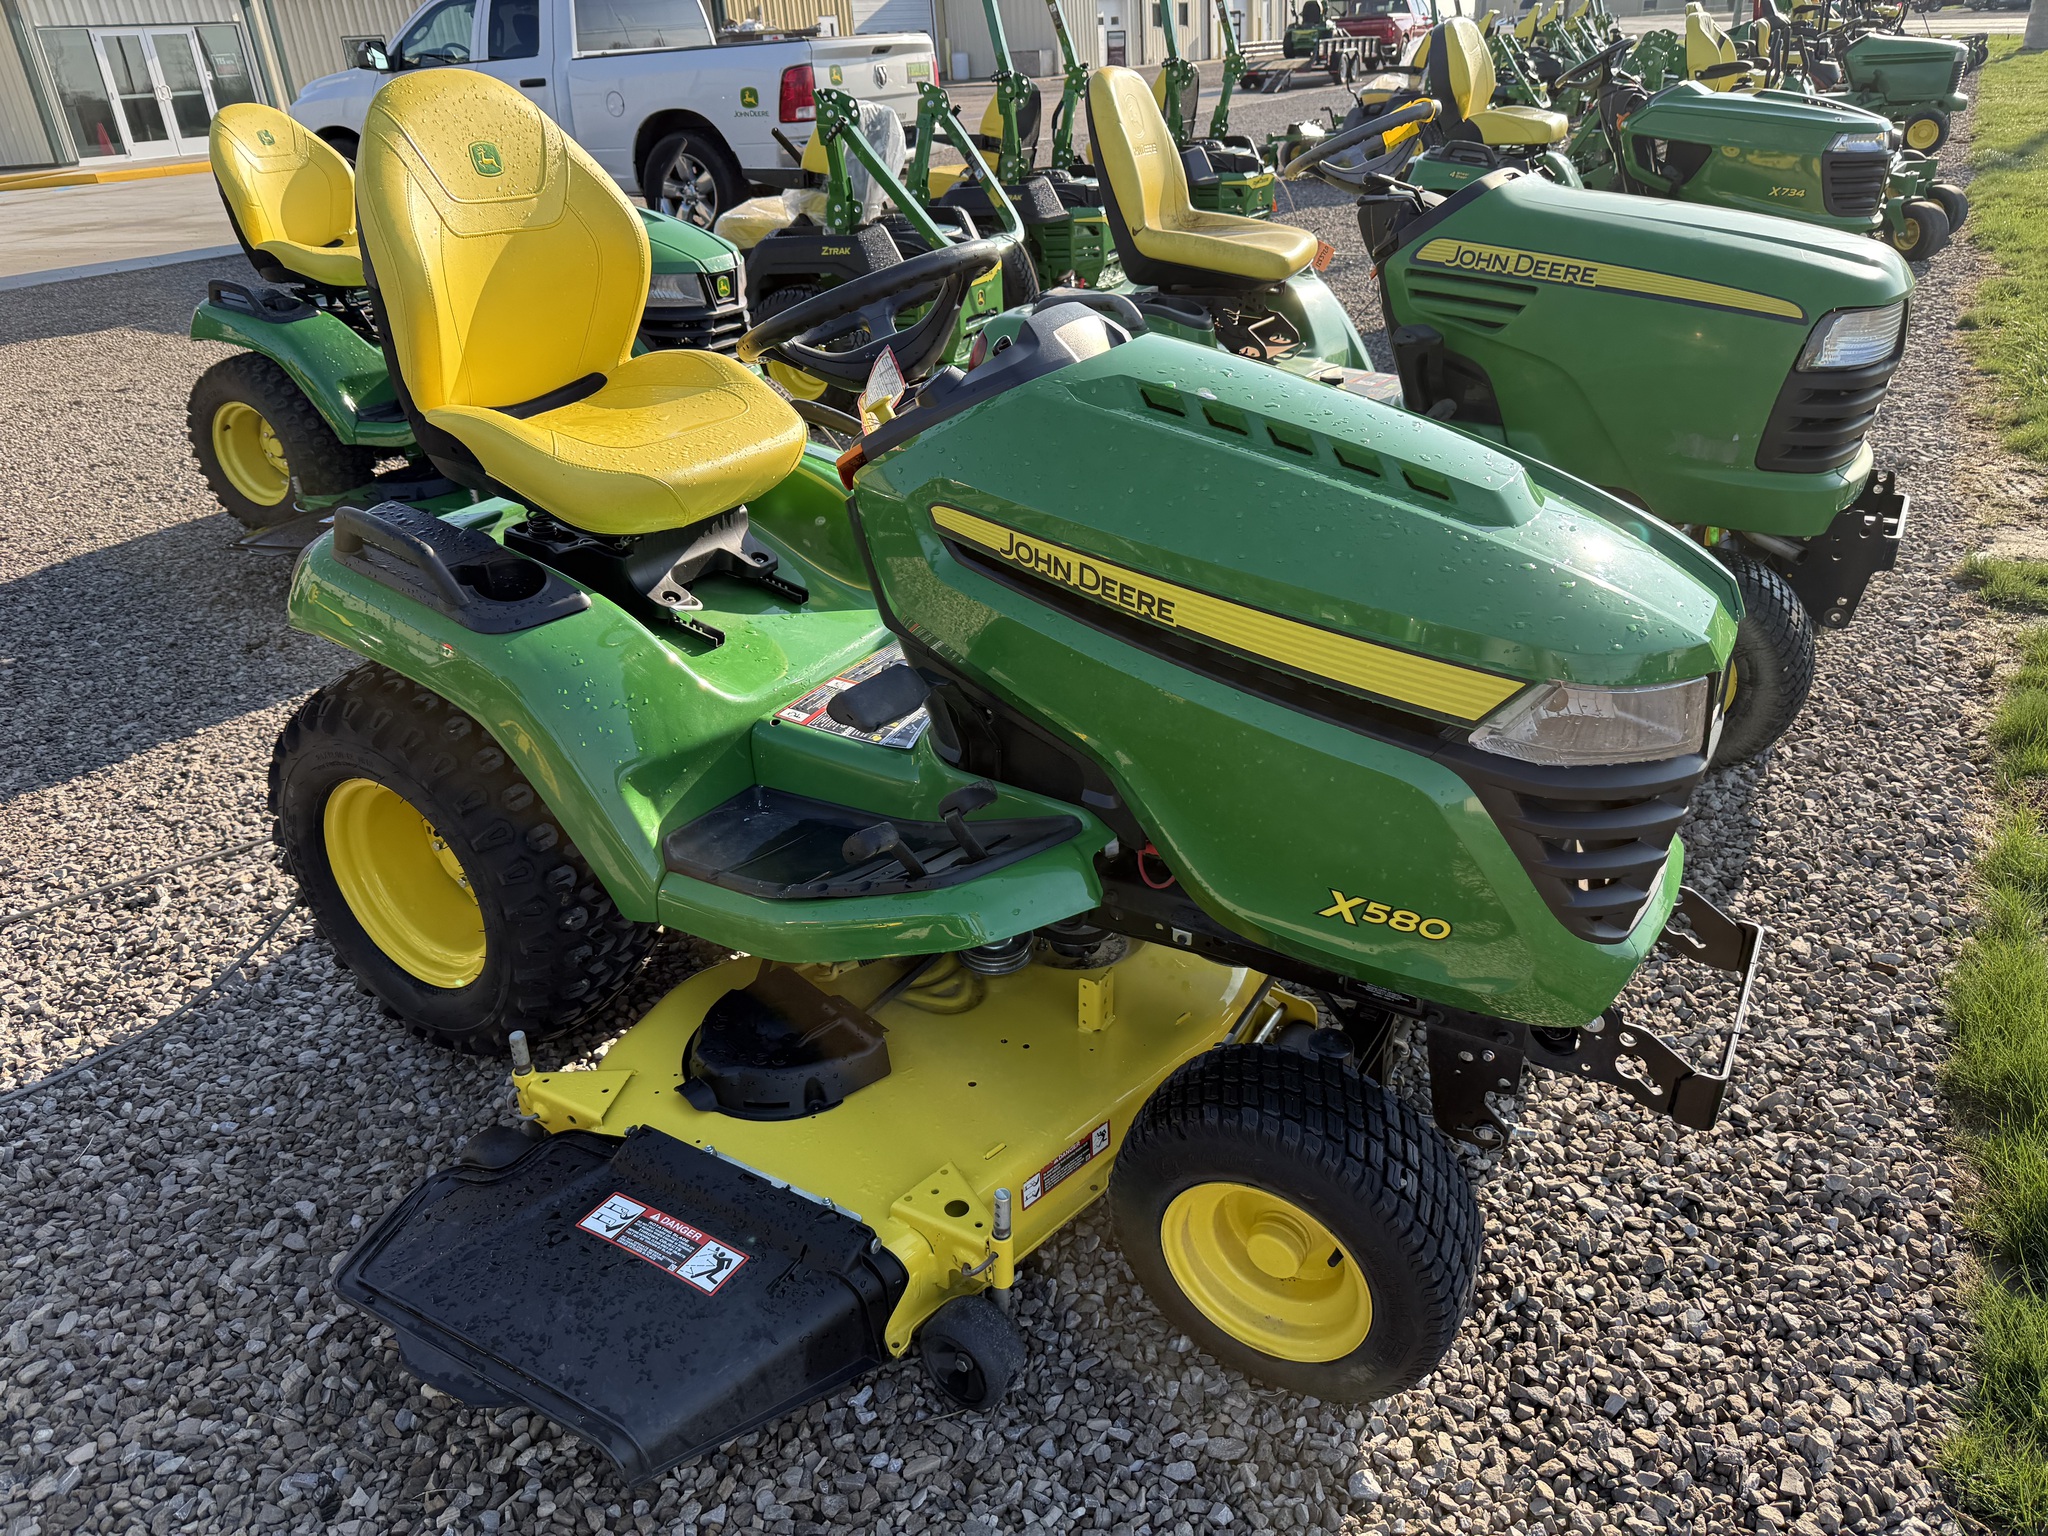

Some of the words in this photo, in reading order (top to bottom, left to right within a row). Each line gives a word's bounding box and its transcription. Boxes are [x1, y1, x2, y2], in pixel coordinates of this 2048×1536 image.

[750, 109, 770, 117] DEERE
[1768, 186, 1805, 197] X734
[821, 246, 851, 256] ZTRAK
[1445, 245, 1510, 272] JOHN
[1513, 253, 1598, 284] DEERE
[999, 533, 1072, 583] JOHN
[1079, 561, 1176, 624] DEERE
[1315, 888, 1452, 940] X580
[1058, 1141, 1081, 1160] DANGER
[660, 1216, 703, 1241] DANGER
